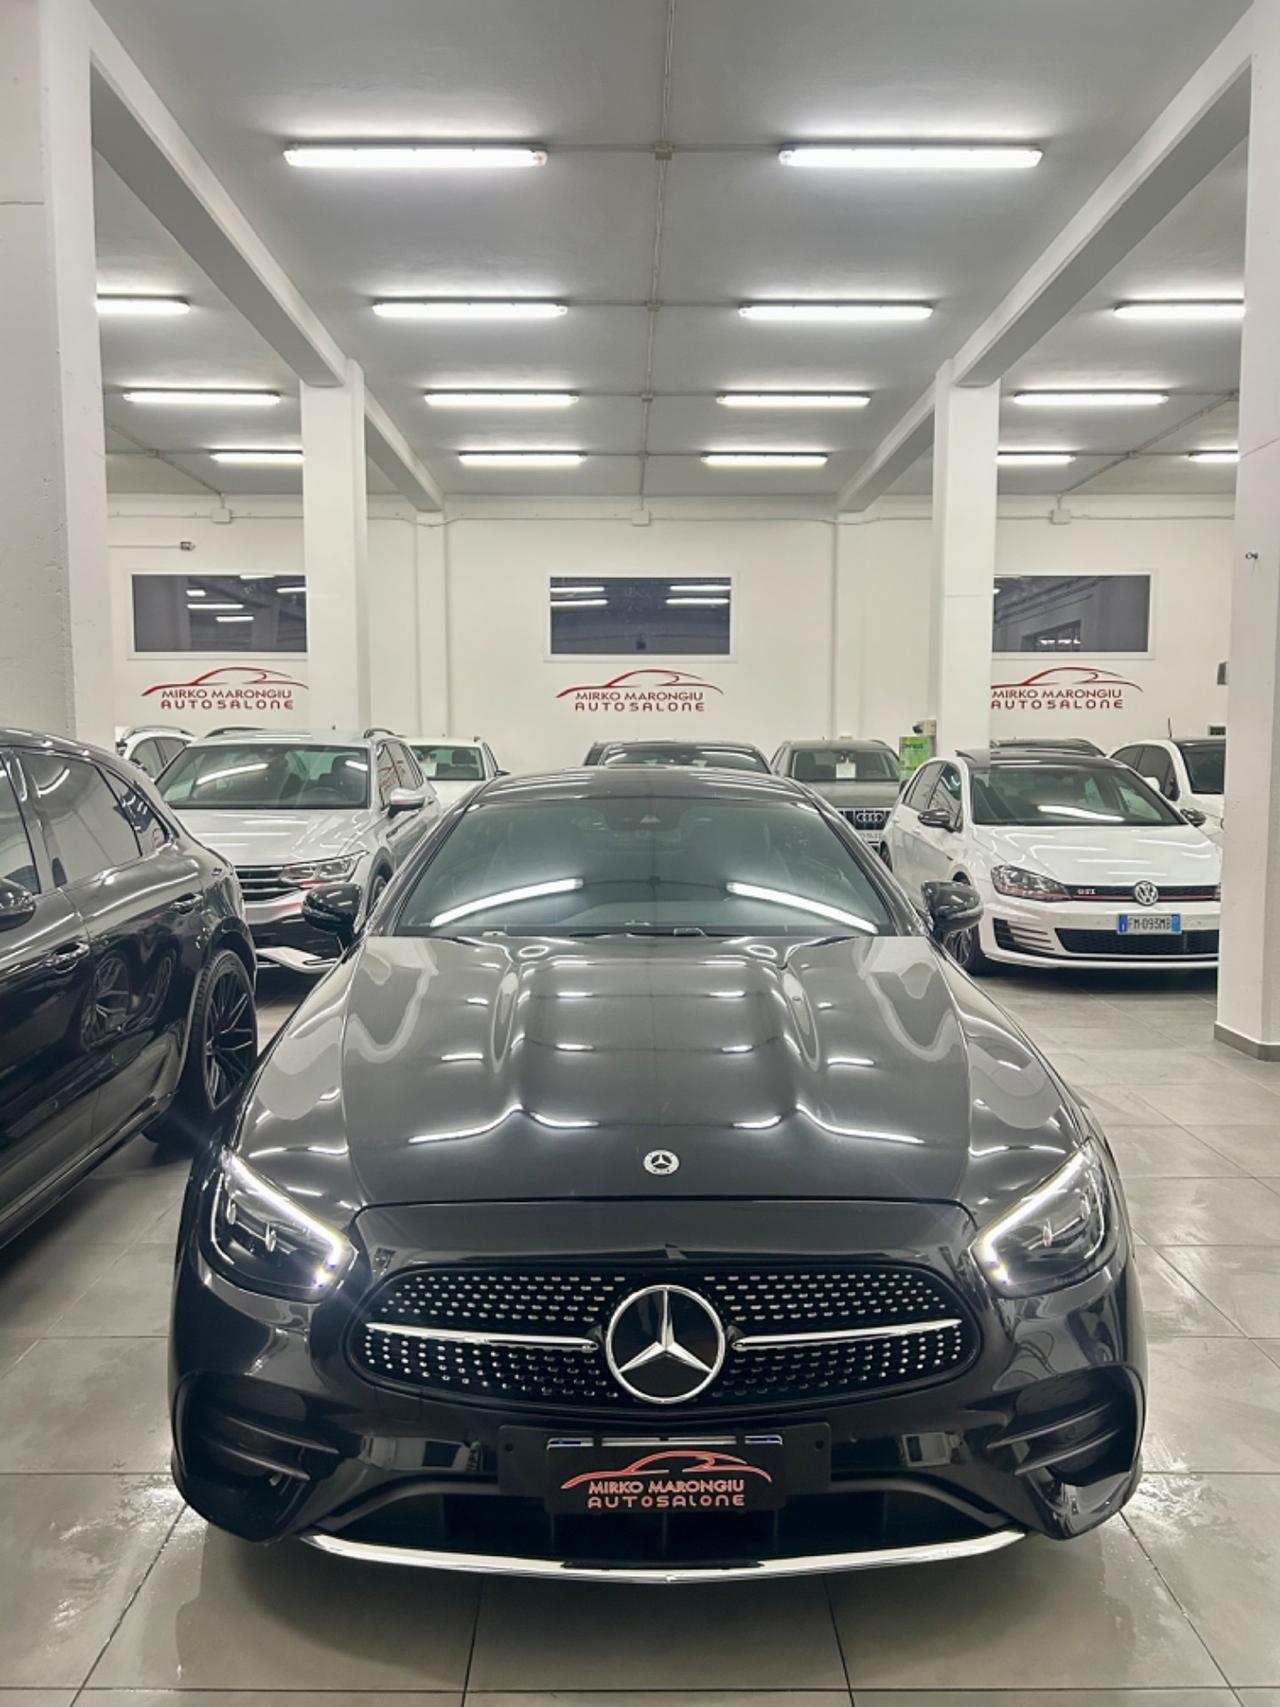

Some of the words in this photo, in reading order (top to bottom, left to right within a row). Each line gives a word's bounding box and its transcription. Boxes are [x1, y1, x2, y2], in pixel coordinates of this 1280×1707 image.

[161, 688, 207, 699] MIRKO
[211, 688, 292, 699] MARONGIU
[575, 691, 621, 701] MIRKO
[624, 691, 704, 701] MARONGIU
[992, 688, 1038, 699] MIRKO
[1041, 688, 1122, 699] MARONGIU
[160, 699, 294, 710] AUTOSALONE
[575, 702, 705, 712] AUTOSALONE
[991, 699, 1123, 710] AUTOSALONE
[588, 1481, 644, 1495] MIRKO
[648, 1479, 744, 1494] MARONGIU
[588, 1494, 745, 1509] AUTOSALONE
